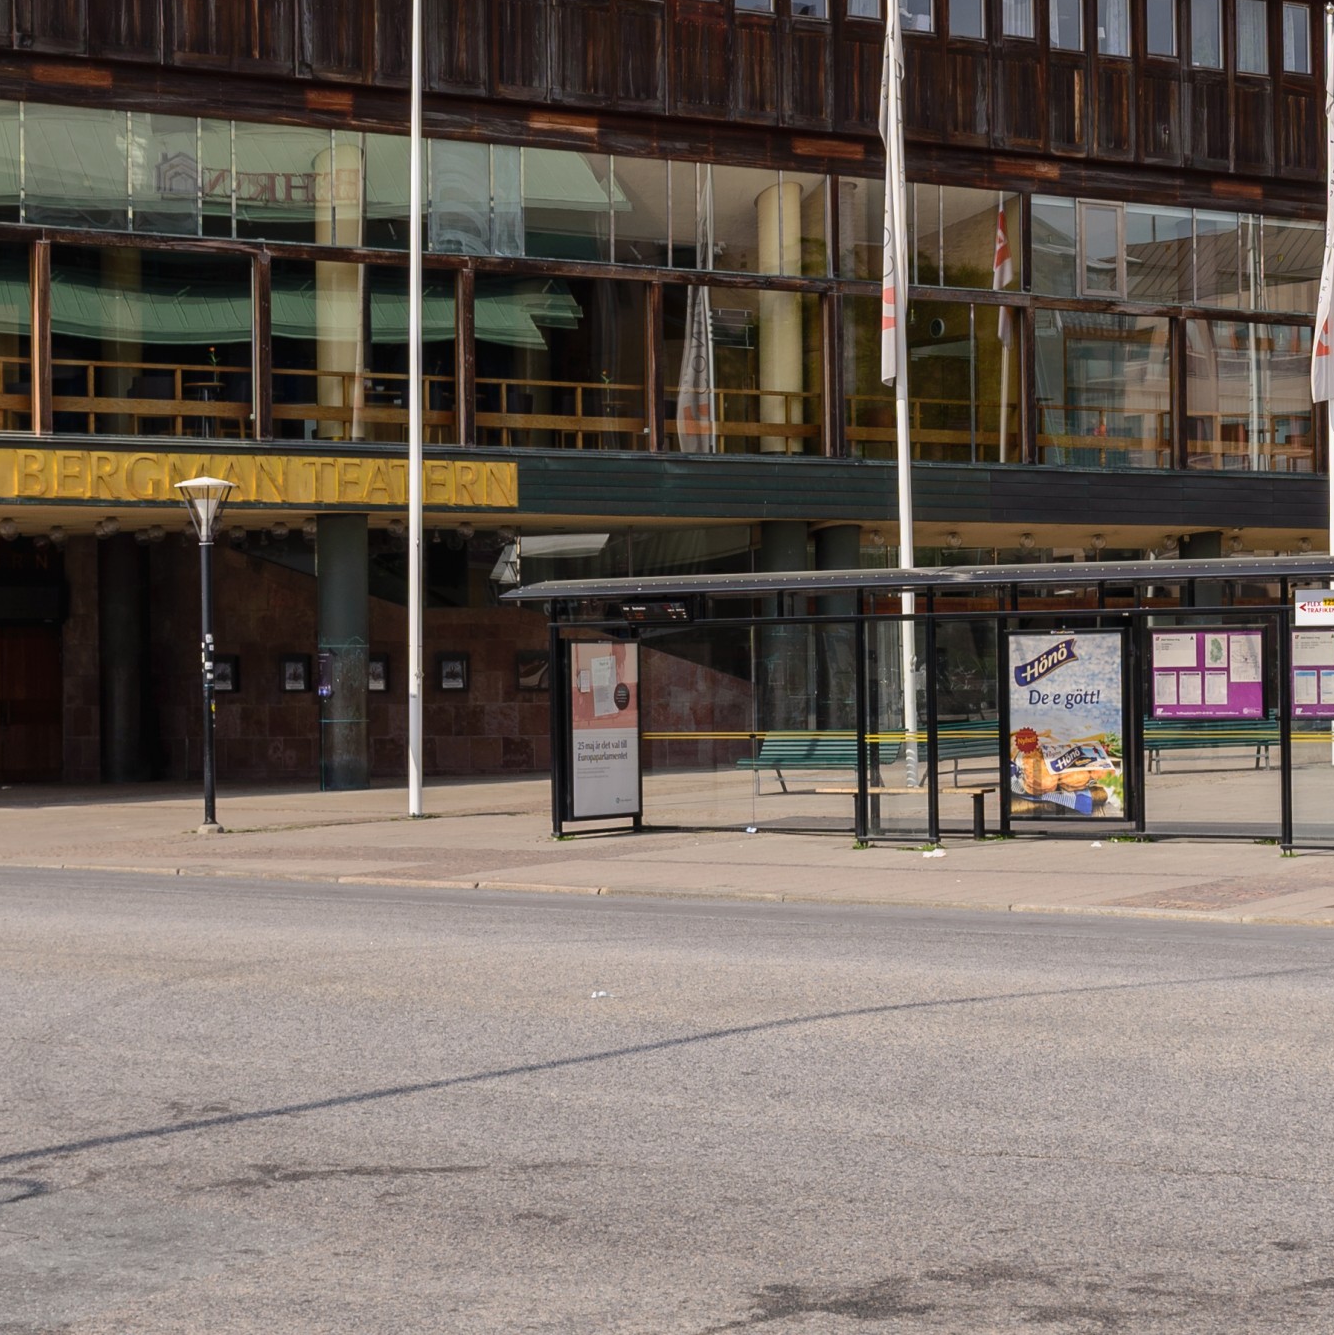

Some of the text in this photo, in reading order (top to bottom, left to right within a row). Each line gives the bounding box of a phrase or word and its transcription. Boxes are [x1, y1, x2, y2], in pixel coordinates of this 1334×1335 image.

[15, 448, 289, 503] BERGMAN
[303, 458, 517, 507] TEATERN
[1021, 643, 1068, 682] Hönö
[1028, 688, 1101, 709] De e gött!
[577, 741, 585, 750] 25
[585, 741, 595, 752] maj
[601, 740, 611, 749] det
[611, 740, 620, 749] val
[577, 752, 628, 764] Europaparlamentet
[1055, 748, 1081, 770] Hönö
